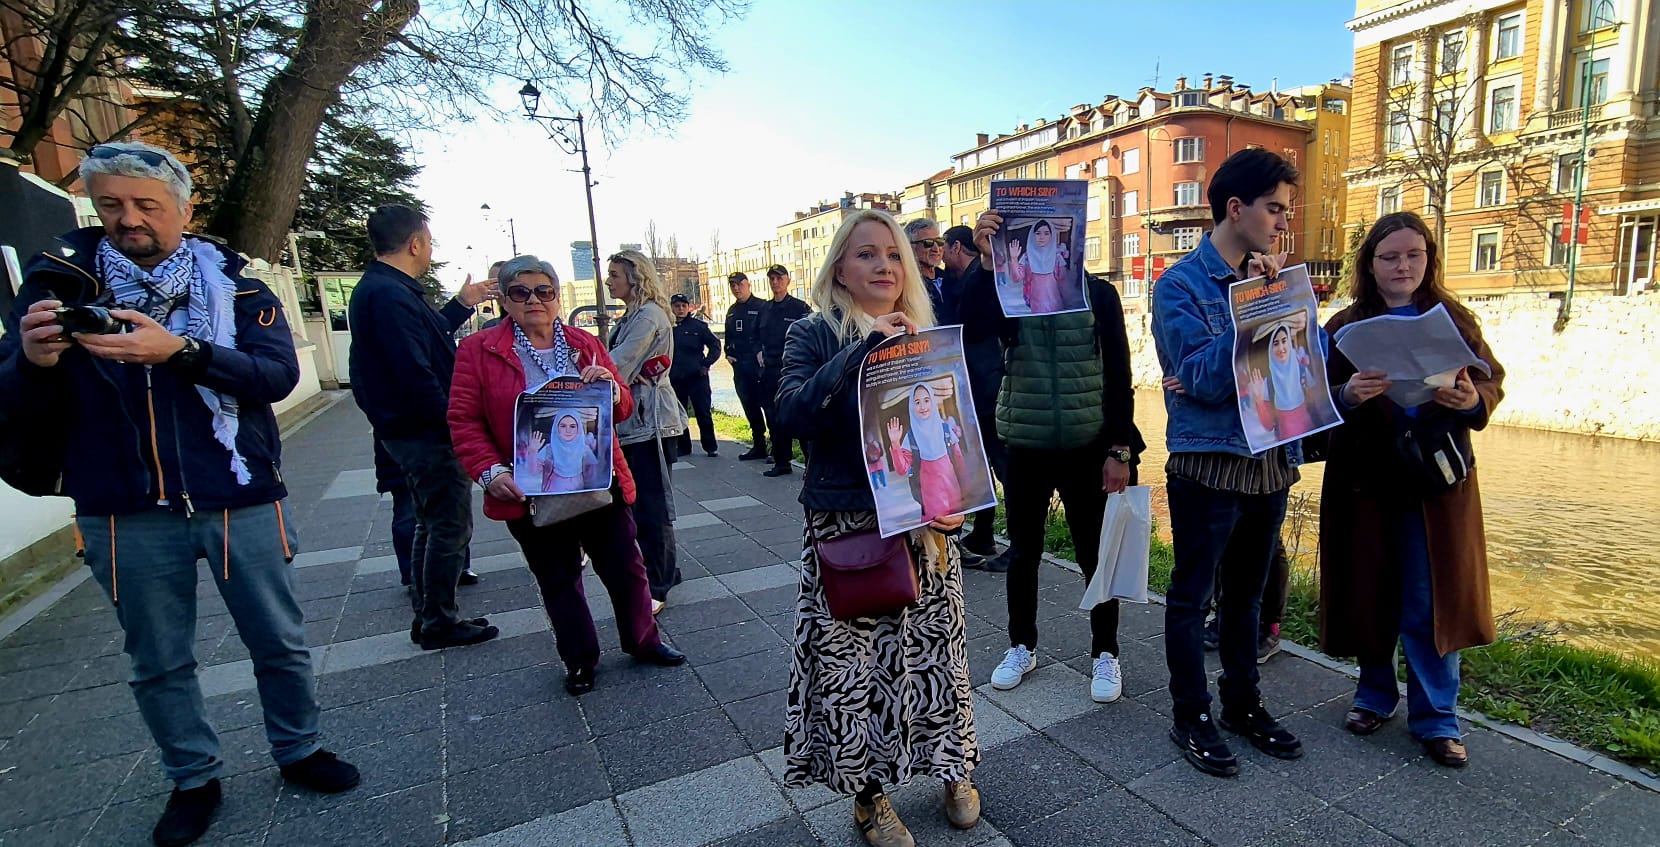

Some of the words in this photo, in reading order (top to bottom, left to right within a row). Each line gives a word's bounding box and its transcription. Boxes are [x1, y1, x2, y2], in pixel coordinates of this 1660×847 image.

[996, 187, 1007, 197] TO
[1009, 186, 1037, 197] WHICH
[1234, 292, 1245, 304] TO
[1244, 285, 1269, 301] WHICH
[867, 352, 879, 365] TO
[878, 343, 906, 361] WHICH
